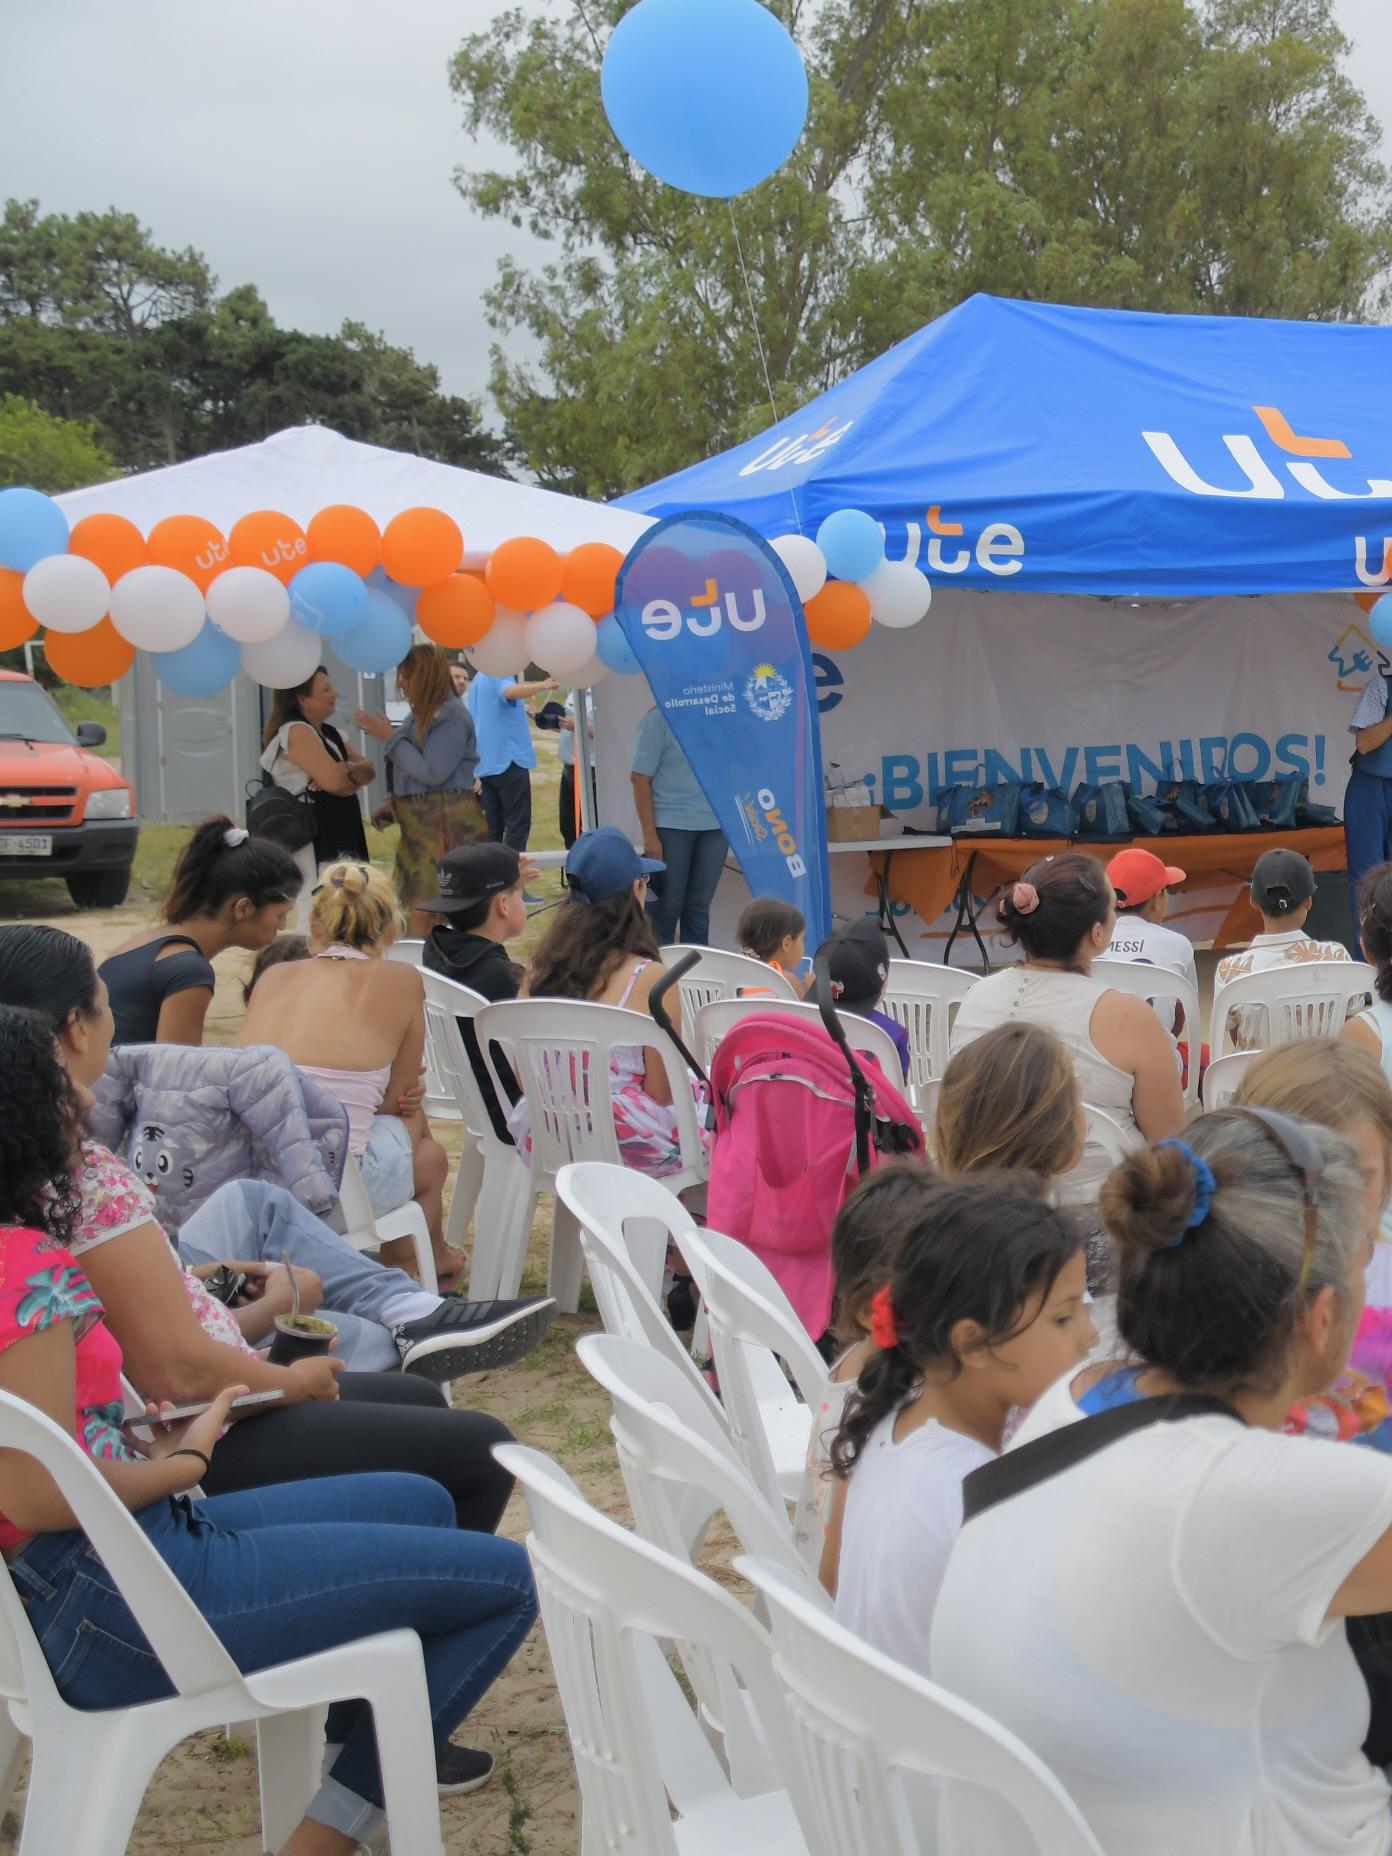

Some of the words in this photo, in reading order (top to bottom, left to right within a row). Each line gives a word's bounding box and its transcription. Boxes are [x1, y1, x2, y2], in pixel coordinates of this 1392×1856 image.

[195, 541, 230, 569] ut
[260, 538, 307, 567] ute
[876, 505, 1025, 576] ute
